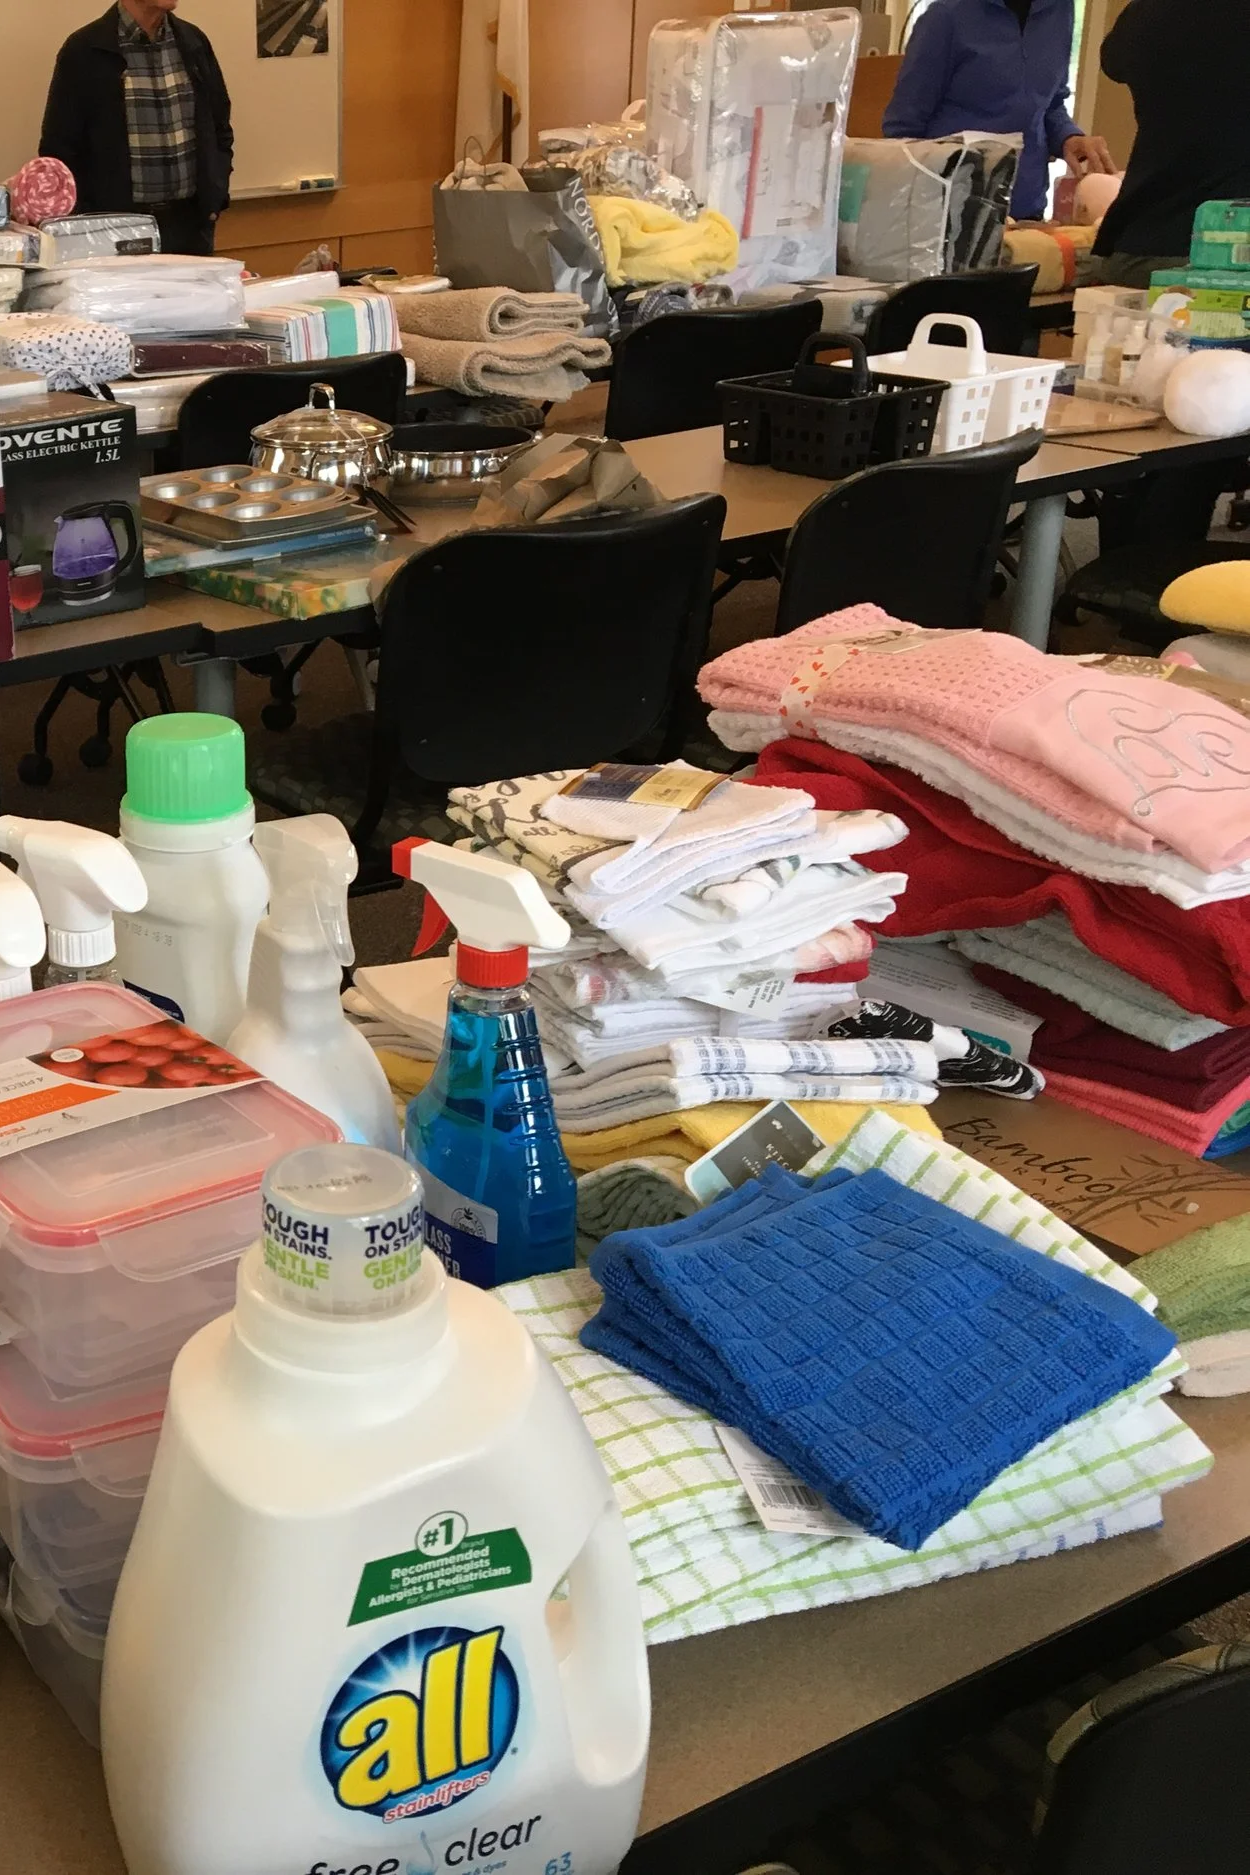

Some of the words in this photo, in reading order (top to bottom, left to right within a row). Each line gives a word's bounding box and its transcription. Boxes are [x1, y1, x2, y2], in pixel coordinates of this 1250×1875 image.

[2, 452, 24, 463] ASS
[26, 443, 79, 459] ELECTRIC
[80, 436, 121, 448] KETTLE
[95, 448, 121, 464] 1.5L
[2, 1079, 37, 1092] PIECE
[945, 1117, 1115, 1194] Bamboo
[953, 1140, 1087, 1201] ATURALS
[263, 1196, 330, 1245] OUGH
[364, 1205, 423, 1244] TOUG
[425, 1220, 452, 1254] LASS
[264, 1238, 330, 1280] ENTLE
[273, 1228, 333, 1260] STAINS.
[364, 1244, 390, 1259] ON
[372, 1277, 396, 1290] ON
[422, 1517, 454, 1548] #1
[461, 1538, 486, 1550] Brand
[391, 1546, 491, 1580] Recommended
[402, 1558, 491, 1588] Dermatologists
[369, 1586, 424, 1608] Allergists
[425, 1582, 435, 1591] &
[437, 1566, 512, 1590] Pediatricians
[407, 1597, 419, 1605] for
[421, 1588, 455, 1602] Sensitive
[457, 1583, 474, 1593] Skin
[336, 1626, 504, 1811] all
[383, 1771, 491, 1824] stainlifters
[445, 1815, 542, 1867] clear
[545, 1852, 572, 1875] 63
